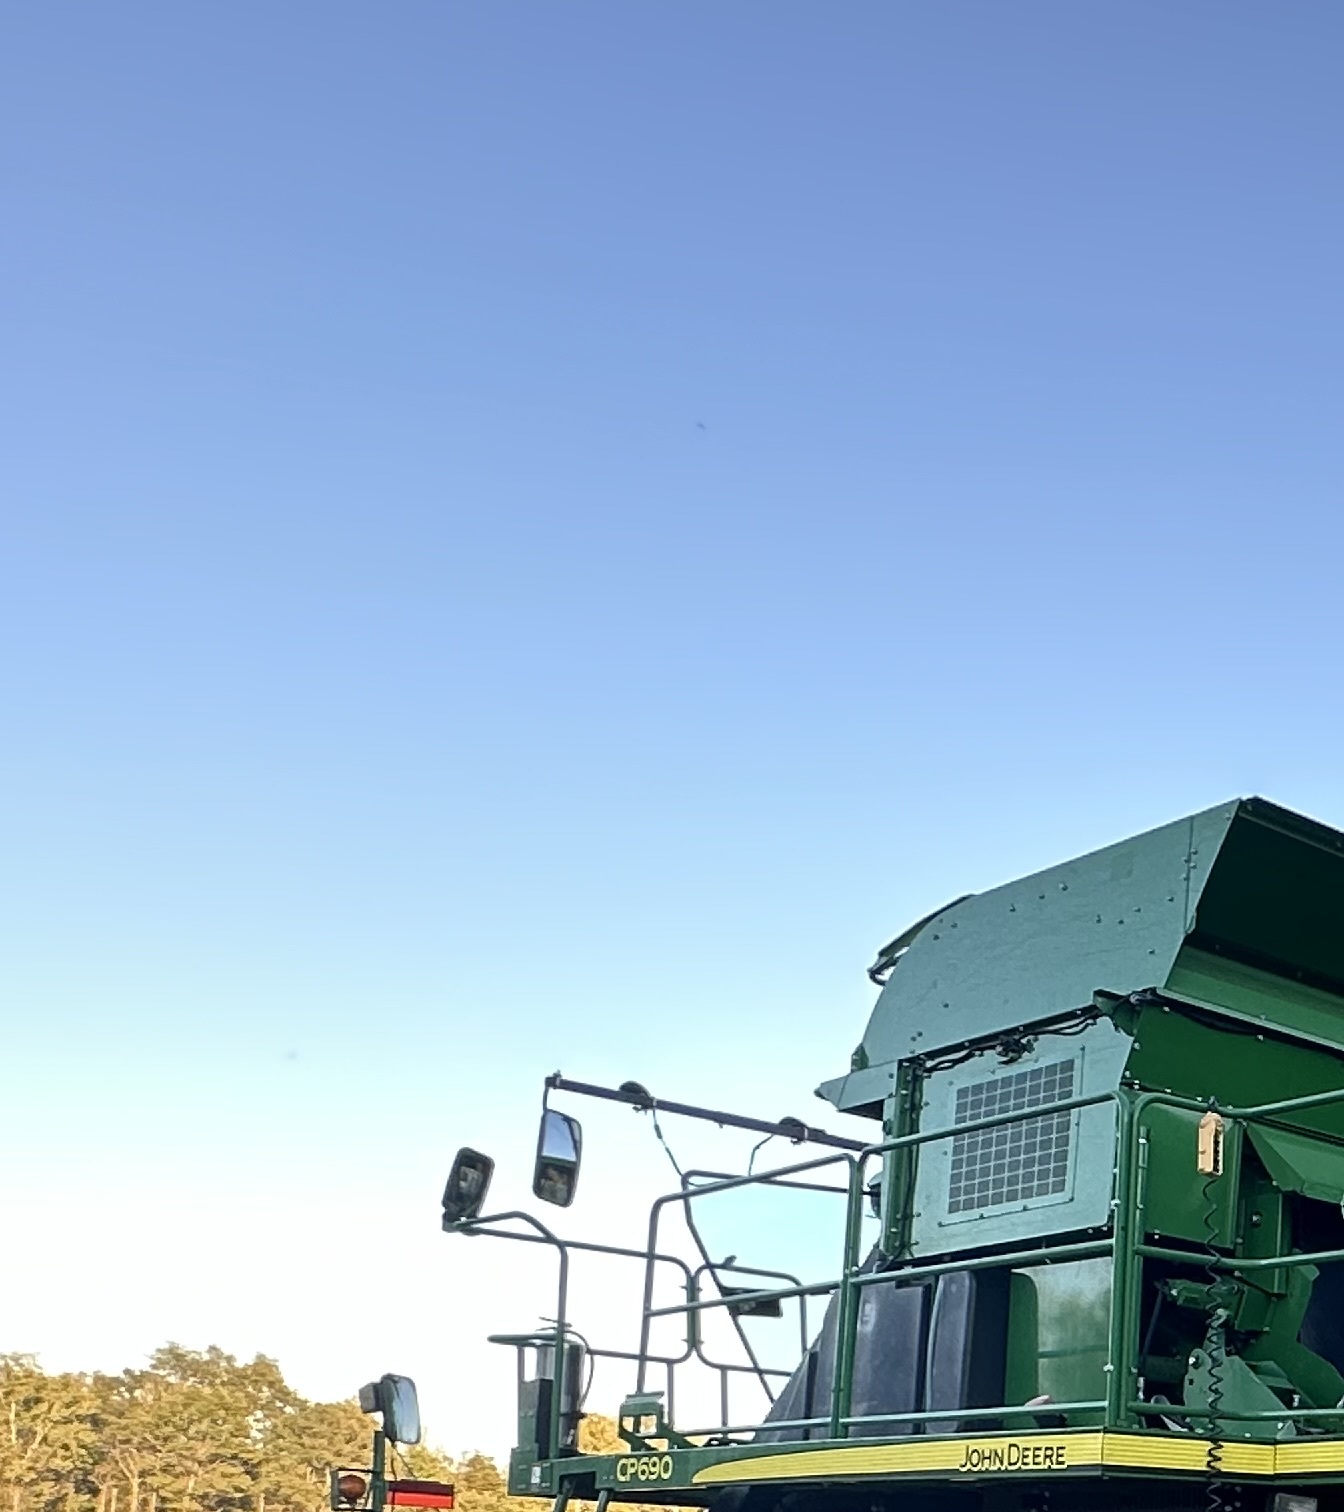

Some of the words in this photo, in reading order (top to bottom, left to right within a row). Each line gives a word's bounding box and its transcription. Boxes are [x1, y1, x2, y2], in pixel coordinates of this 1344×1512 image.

[617, 1455, 673, 1482] CP690
[959, 1444, 1005, 1468] JOHN
[1007, 1443, 1066, 1466] DEERE
